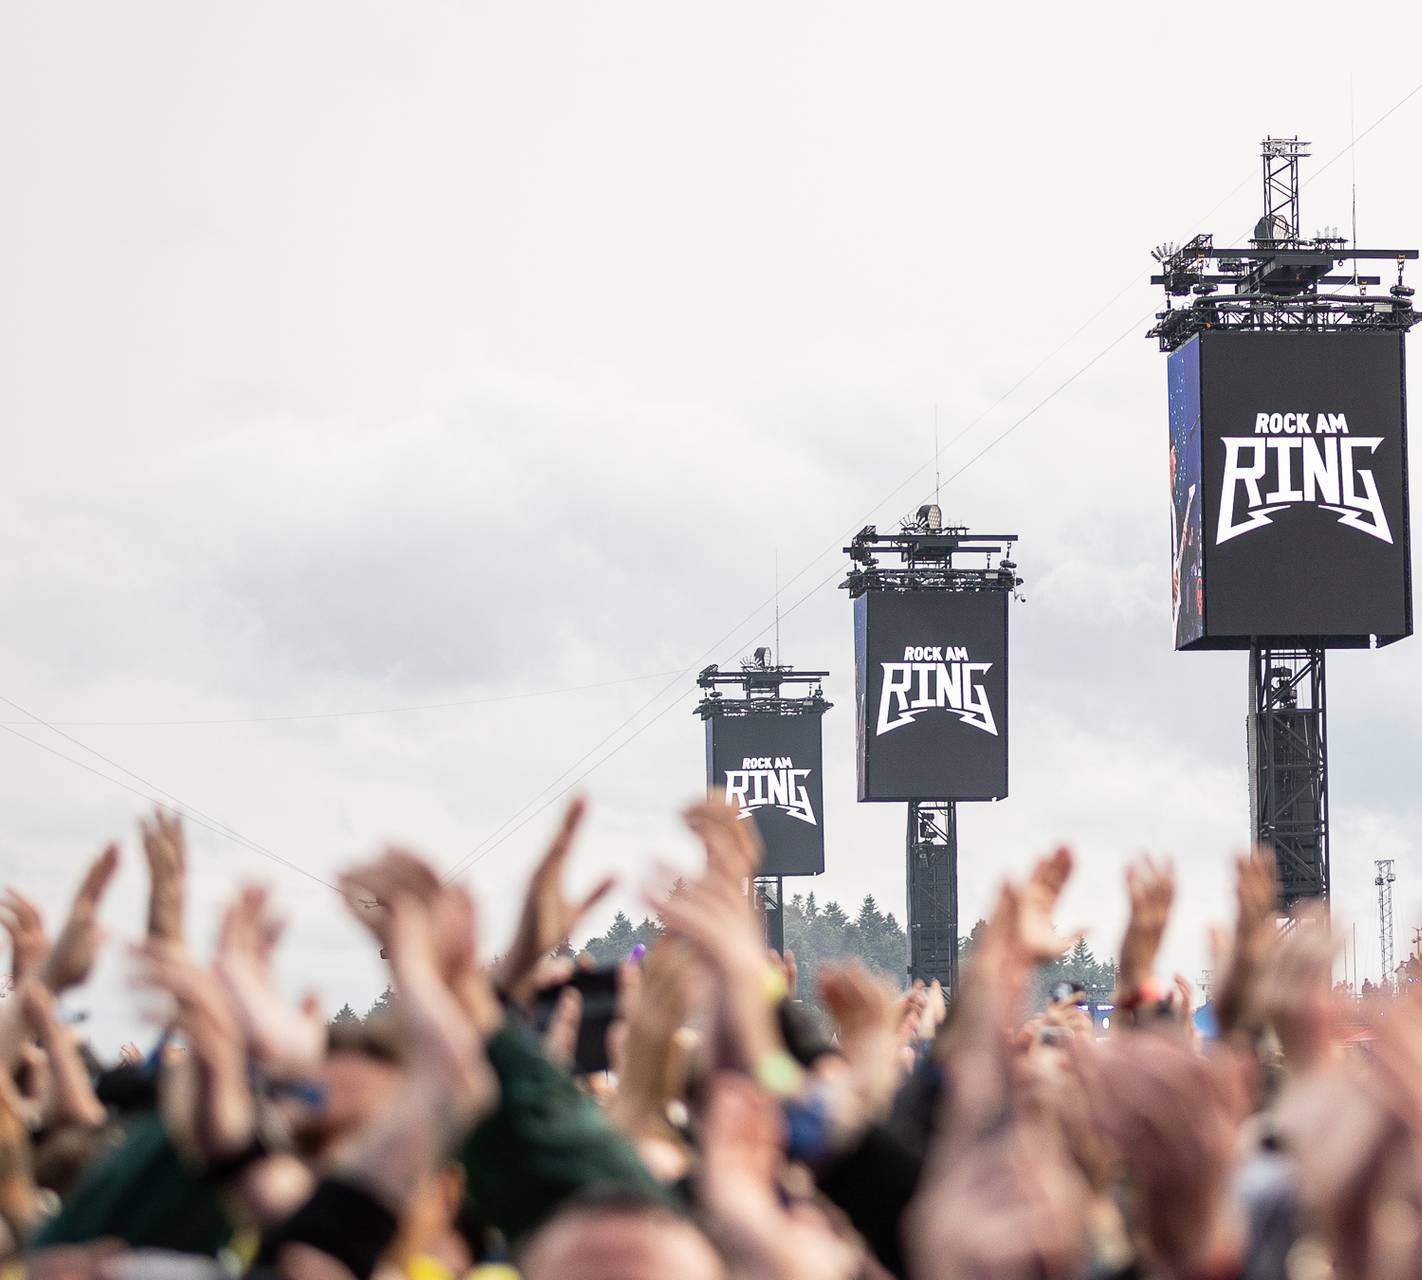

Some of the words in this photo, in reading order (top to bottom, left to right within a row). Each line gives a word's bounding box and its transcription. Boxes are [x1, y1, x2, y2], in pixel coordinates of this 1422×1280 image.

[1254, 412, 1312, 434] ROCK
[1315, 412, 1350, 434] AM
[1215, 436, 1394, 546] RING
[903, 646, 945, 662] ROCK
[945, 646, 969, 661] AM
[876, 662, 999, 737] RING
[742, 757, 773, 770] ROCK
[774, 756, 793, 769] AM
[724, 768, 817, 826] RING
